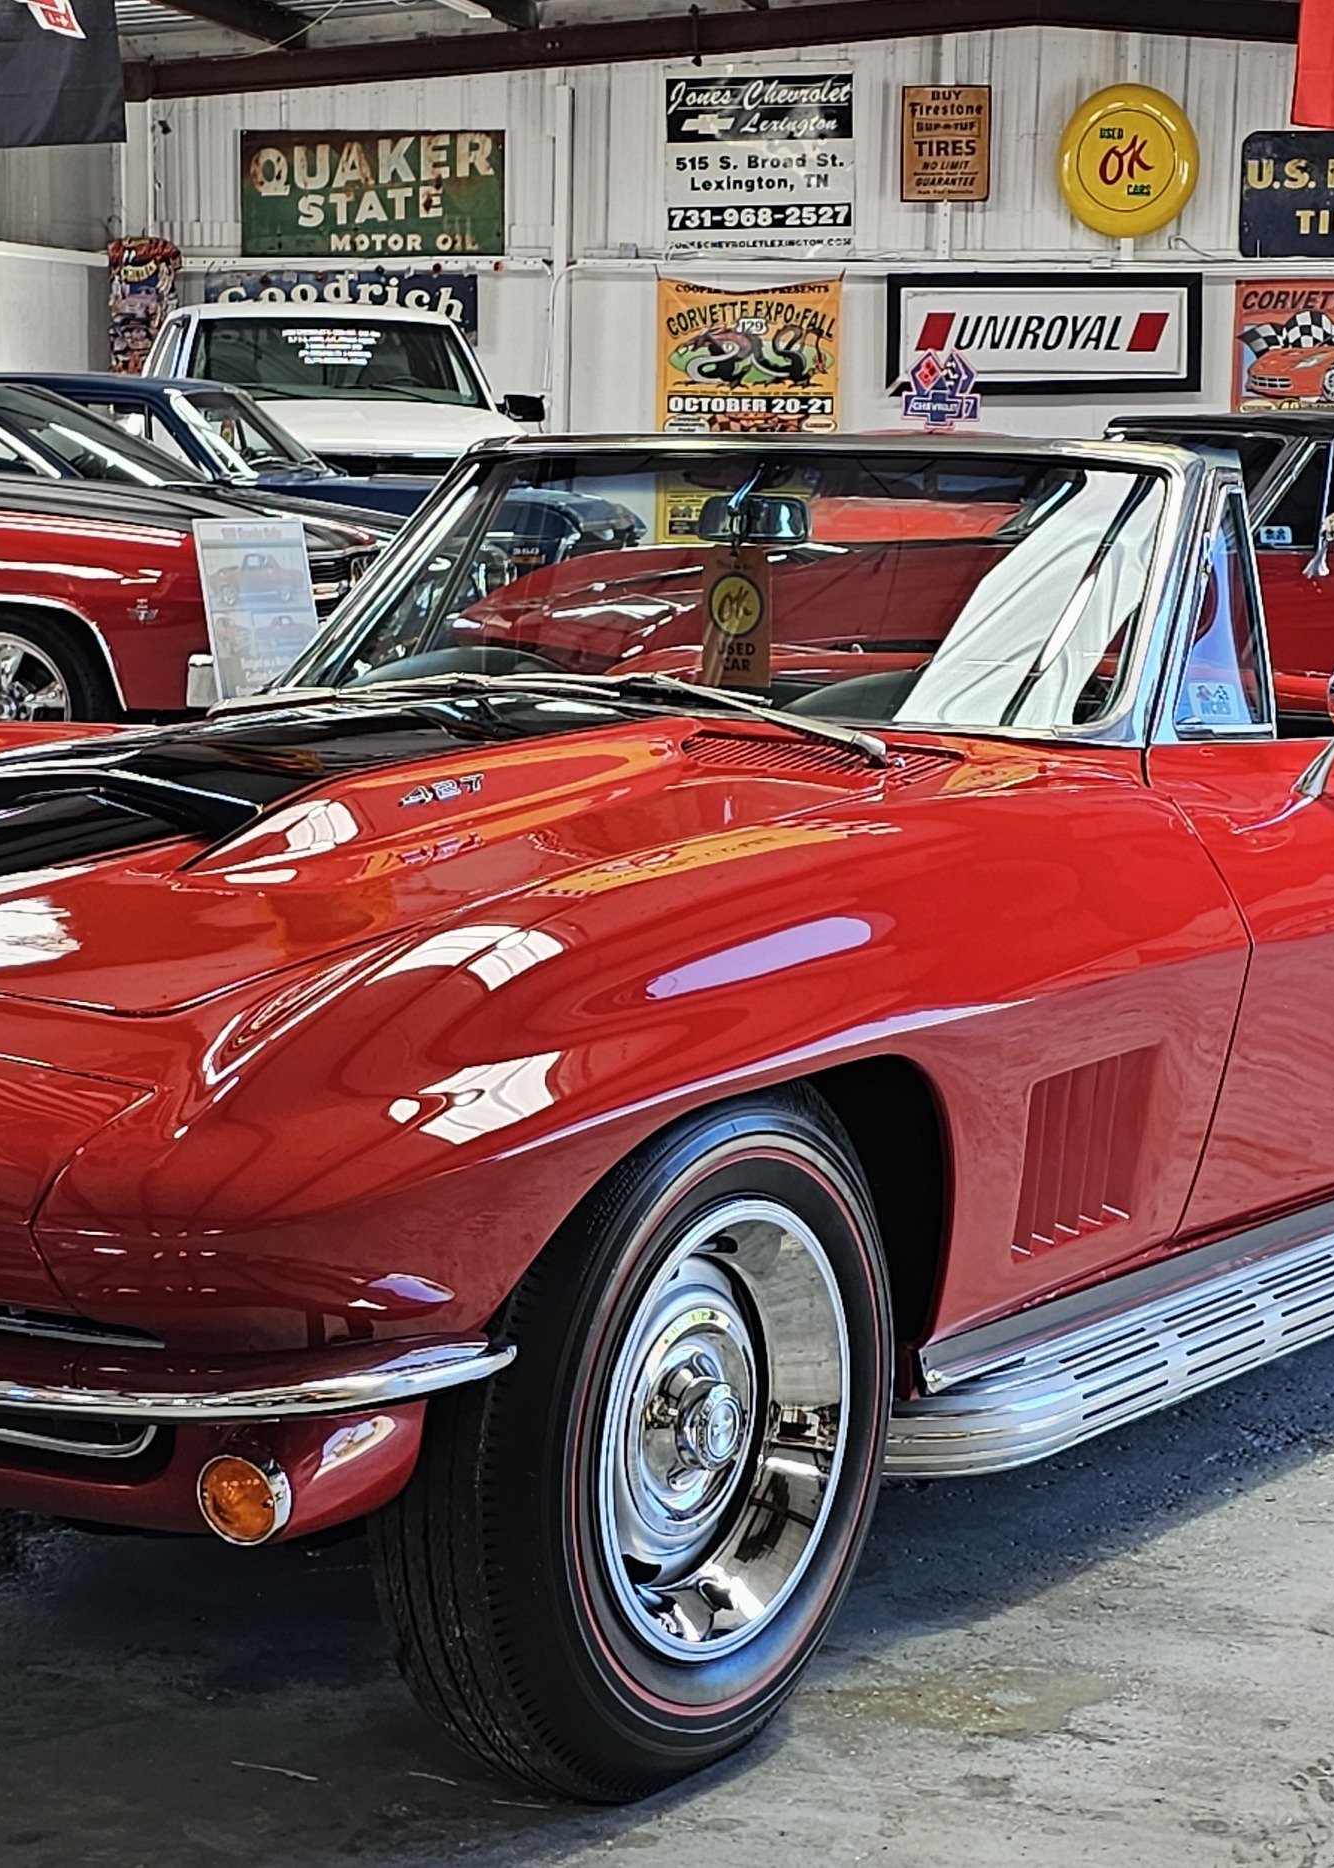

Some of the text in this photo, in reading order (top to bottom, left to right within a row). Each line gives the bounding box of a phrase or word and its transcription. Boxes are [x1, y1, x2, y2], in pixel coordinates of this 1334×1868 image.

[667, 75, 852, 115] Jones Chevrolet
[931, 90, 962, 101] BUY
[909, 102, 983, 117] Firestone
[740, 112, 838, 137] Lexington
[1100, 128, 1124, 139] USED
[913, 140, 976, 157] TIRES
[250, 132, 495, 197] QUAKER
[675, 154, 844, 171] 515 S. Broad St.
[922, 161, 970, 170] NO LIMIT
[1099, 134, 1155, 186] OK
[690, 174, 829, 192] Lexington, TN
[915, 177, 976, 187] GUARANTEE
[1247, 158, 1317, 190] U.S.
[297, 186, 443, 227] STATE
[669, 205, 849, 228] 731-968-2527
[330, 233, 480, 251] MOTOR OIL
[667, 301, 749, 336] CORVETTE
[953, 315, 1123, 350] UNIROYAL
[669, 397, 832, 414] OCTOBER 20-21
[717, 585, 753, 624] OK
[717, 642, 756, 656] USED
[397, 772, 485, 808] 427
